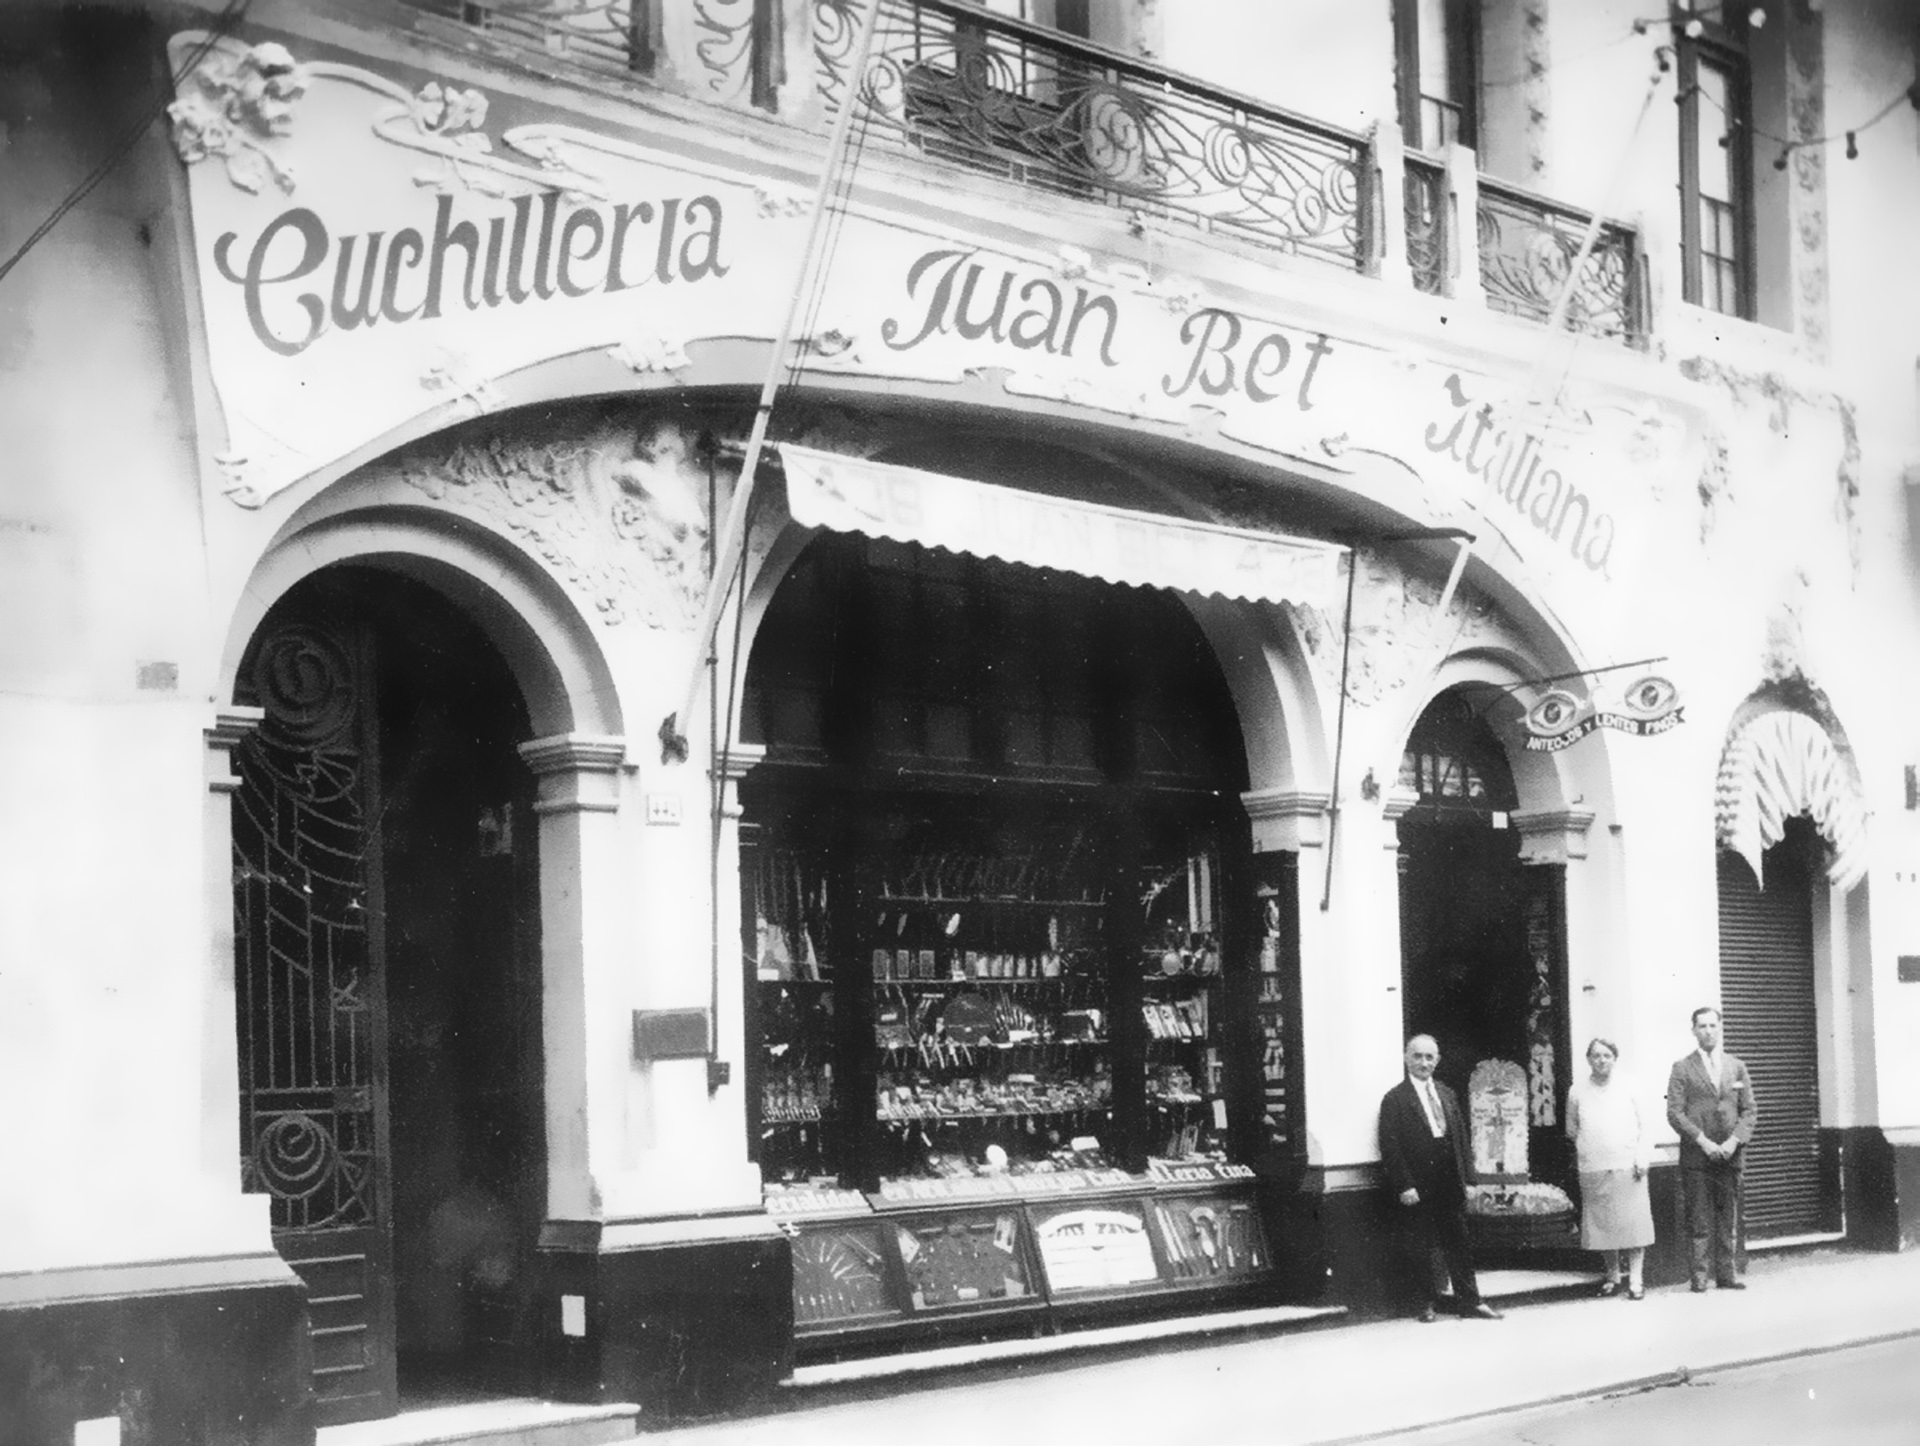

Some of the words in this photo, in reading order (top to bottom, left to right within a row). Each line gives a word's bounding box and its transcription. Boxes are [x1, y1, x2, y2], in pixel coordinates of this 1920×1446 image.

[213, 192, 731, 357] Cuchilleria
[881, 249, 1120, 367] Juan
[1161, 306, 1334, 411] Bet
[1424, 372, 1616, 583] Italiana
[957, 492, 1095, 560] JUAN
[1526, 726, 1583, 752] ANTEOJOS
[1583, 721, 1592, 732] Y
[1594, 713, 1639, 734] LENTES
[1644, 711, 1679, 735] FINOS
